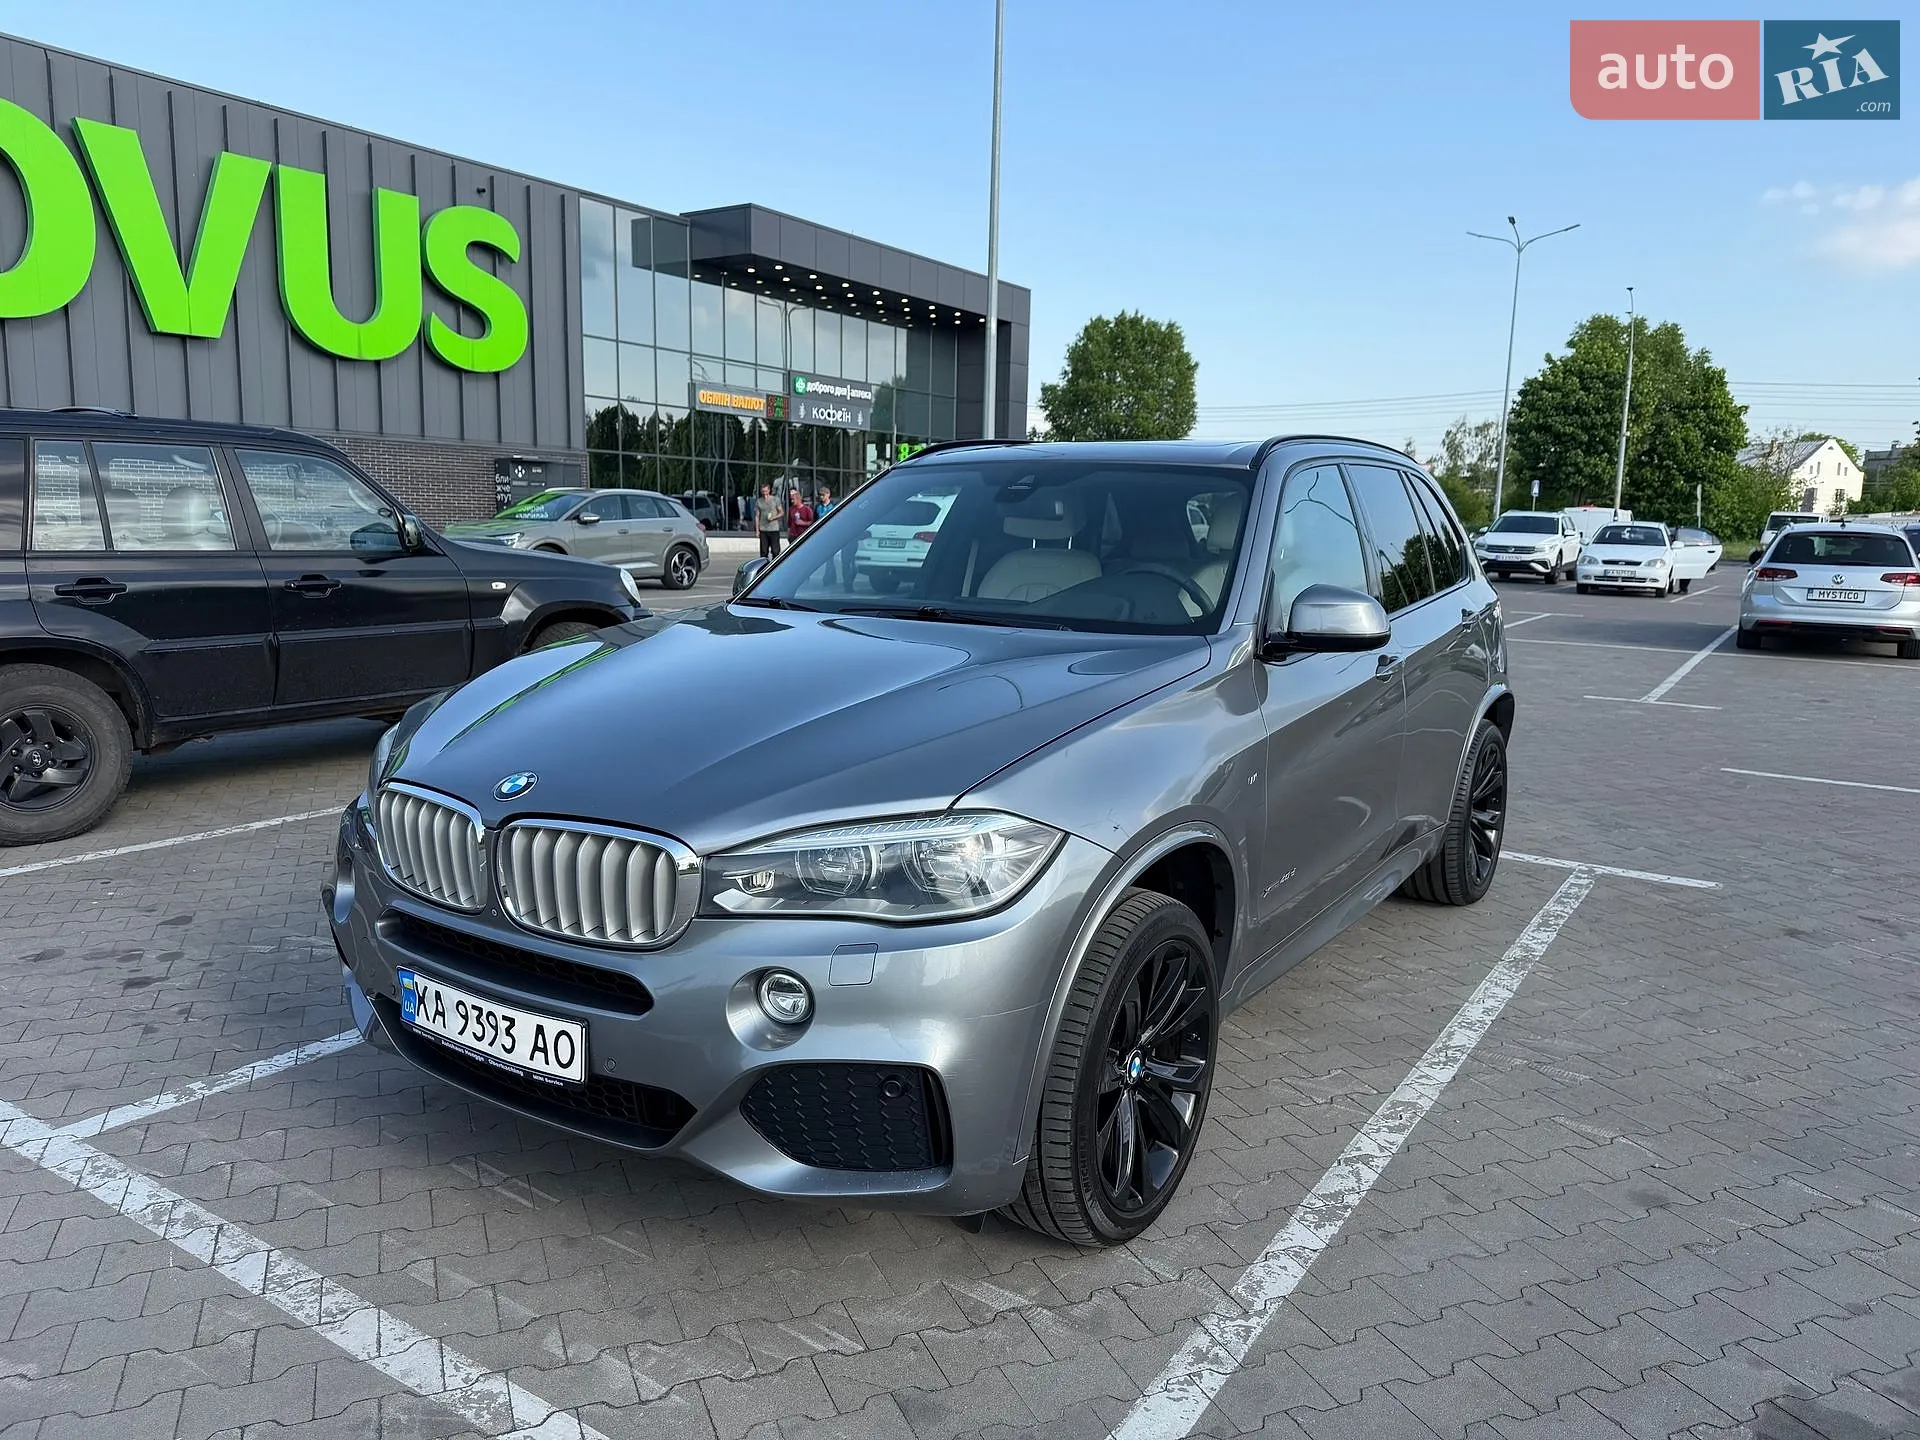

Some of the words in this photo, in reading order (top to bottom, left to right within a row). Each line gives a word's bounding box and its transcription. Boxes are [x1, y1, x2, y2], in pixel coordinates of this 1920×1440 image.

[699, 389, 731, 406] ОБМІН
[731, 394, 765, 411] ВАЛЮТ
[806, 381, 835, 395] доброго
[850, 388, 872, 400] аптека
[812, 403, 852, 424] кофеїн
[1818, 590, 1859, 600] MYSTICO
[404, 1000, 415, 1015] UA
[414, 980, 447, 1030] KA
[455, 999, 516, 1055] 9393
[529, 1023, 576, 1070] AO
